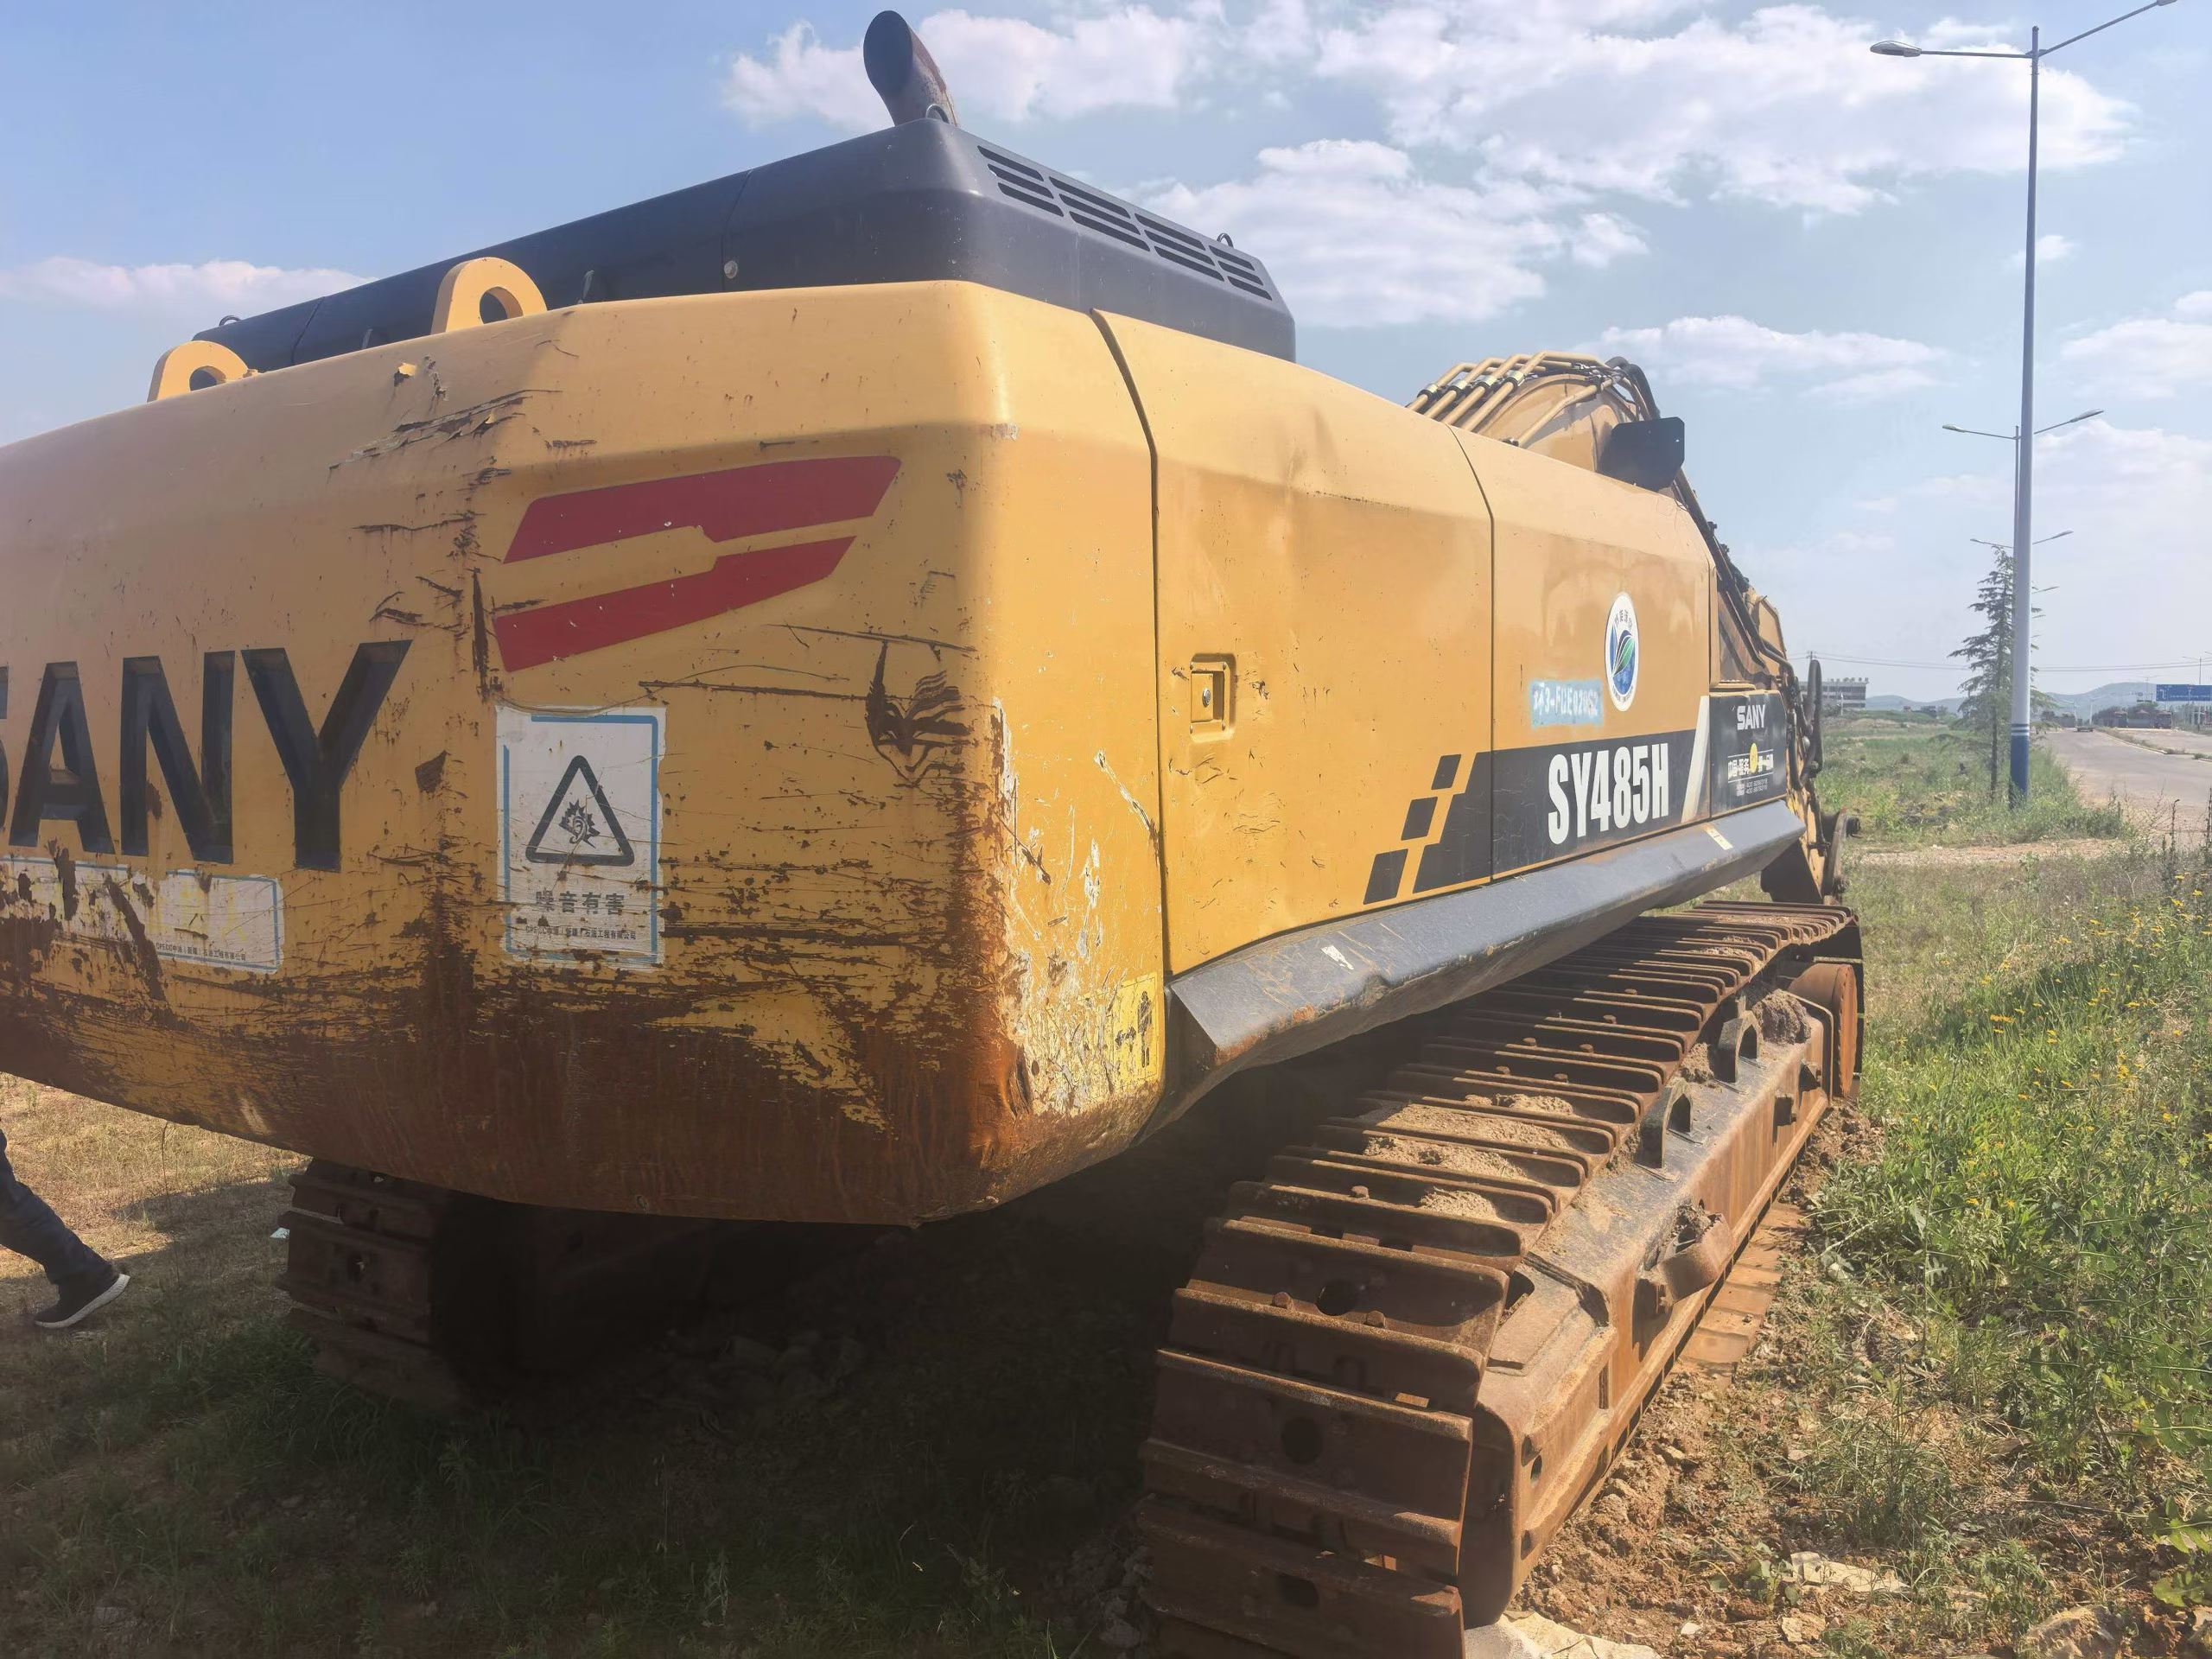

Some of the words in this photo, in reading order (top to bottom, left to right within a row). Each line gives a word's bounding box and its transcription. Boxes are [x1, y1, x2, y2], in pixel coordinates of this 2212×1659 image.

[1737, 704, 1766, 730] SANY
[0, 639, 413, 873] ANY
[1548, 742, 1669, 845] SY485H
[536, 889, 625, 915] 噪音有害
